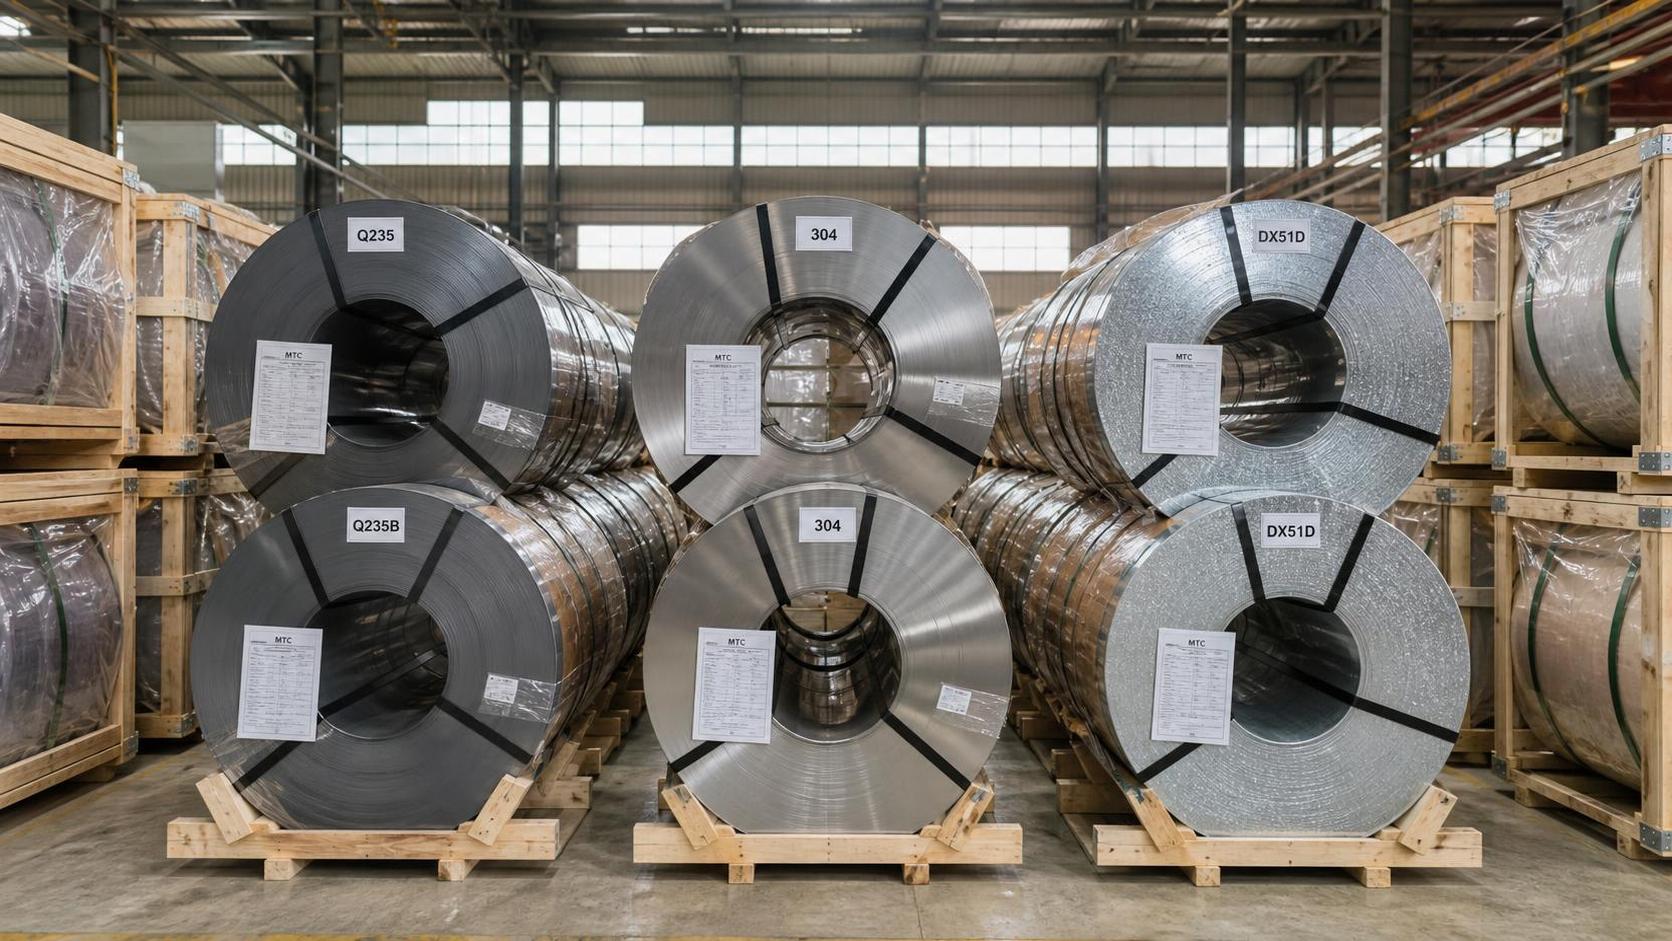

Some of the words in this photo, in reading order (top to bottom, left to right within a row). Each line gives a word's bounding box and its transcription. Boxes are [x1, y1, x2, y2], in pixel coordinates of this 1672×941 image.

[357, 229, 395, 243] Q235
[811, 228, 837, 241] 304
[1258, 230, 1306, 243] DX51D
[1176, 353, 1192, 361] MTC
[353, 520, 400, 533] Q235B
[814, 519, 841, 532] 304
[1267, 525, 1316, 538] DX51D
[275, 636, 292, 644] MTC
[728, 638, 746, 646] MTC
[1188, 639, 1205, 647] MTC
